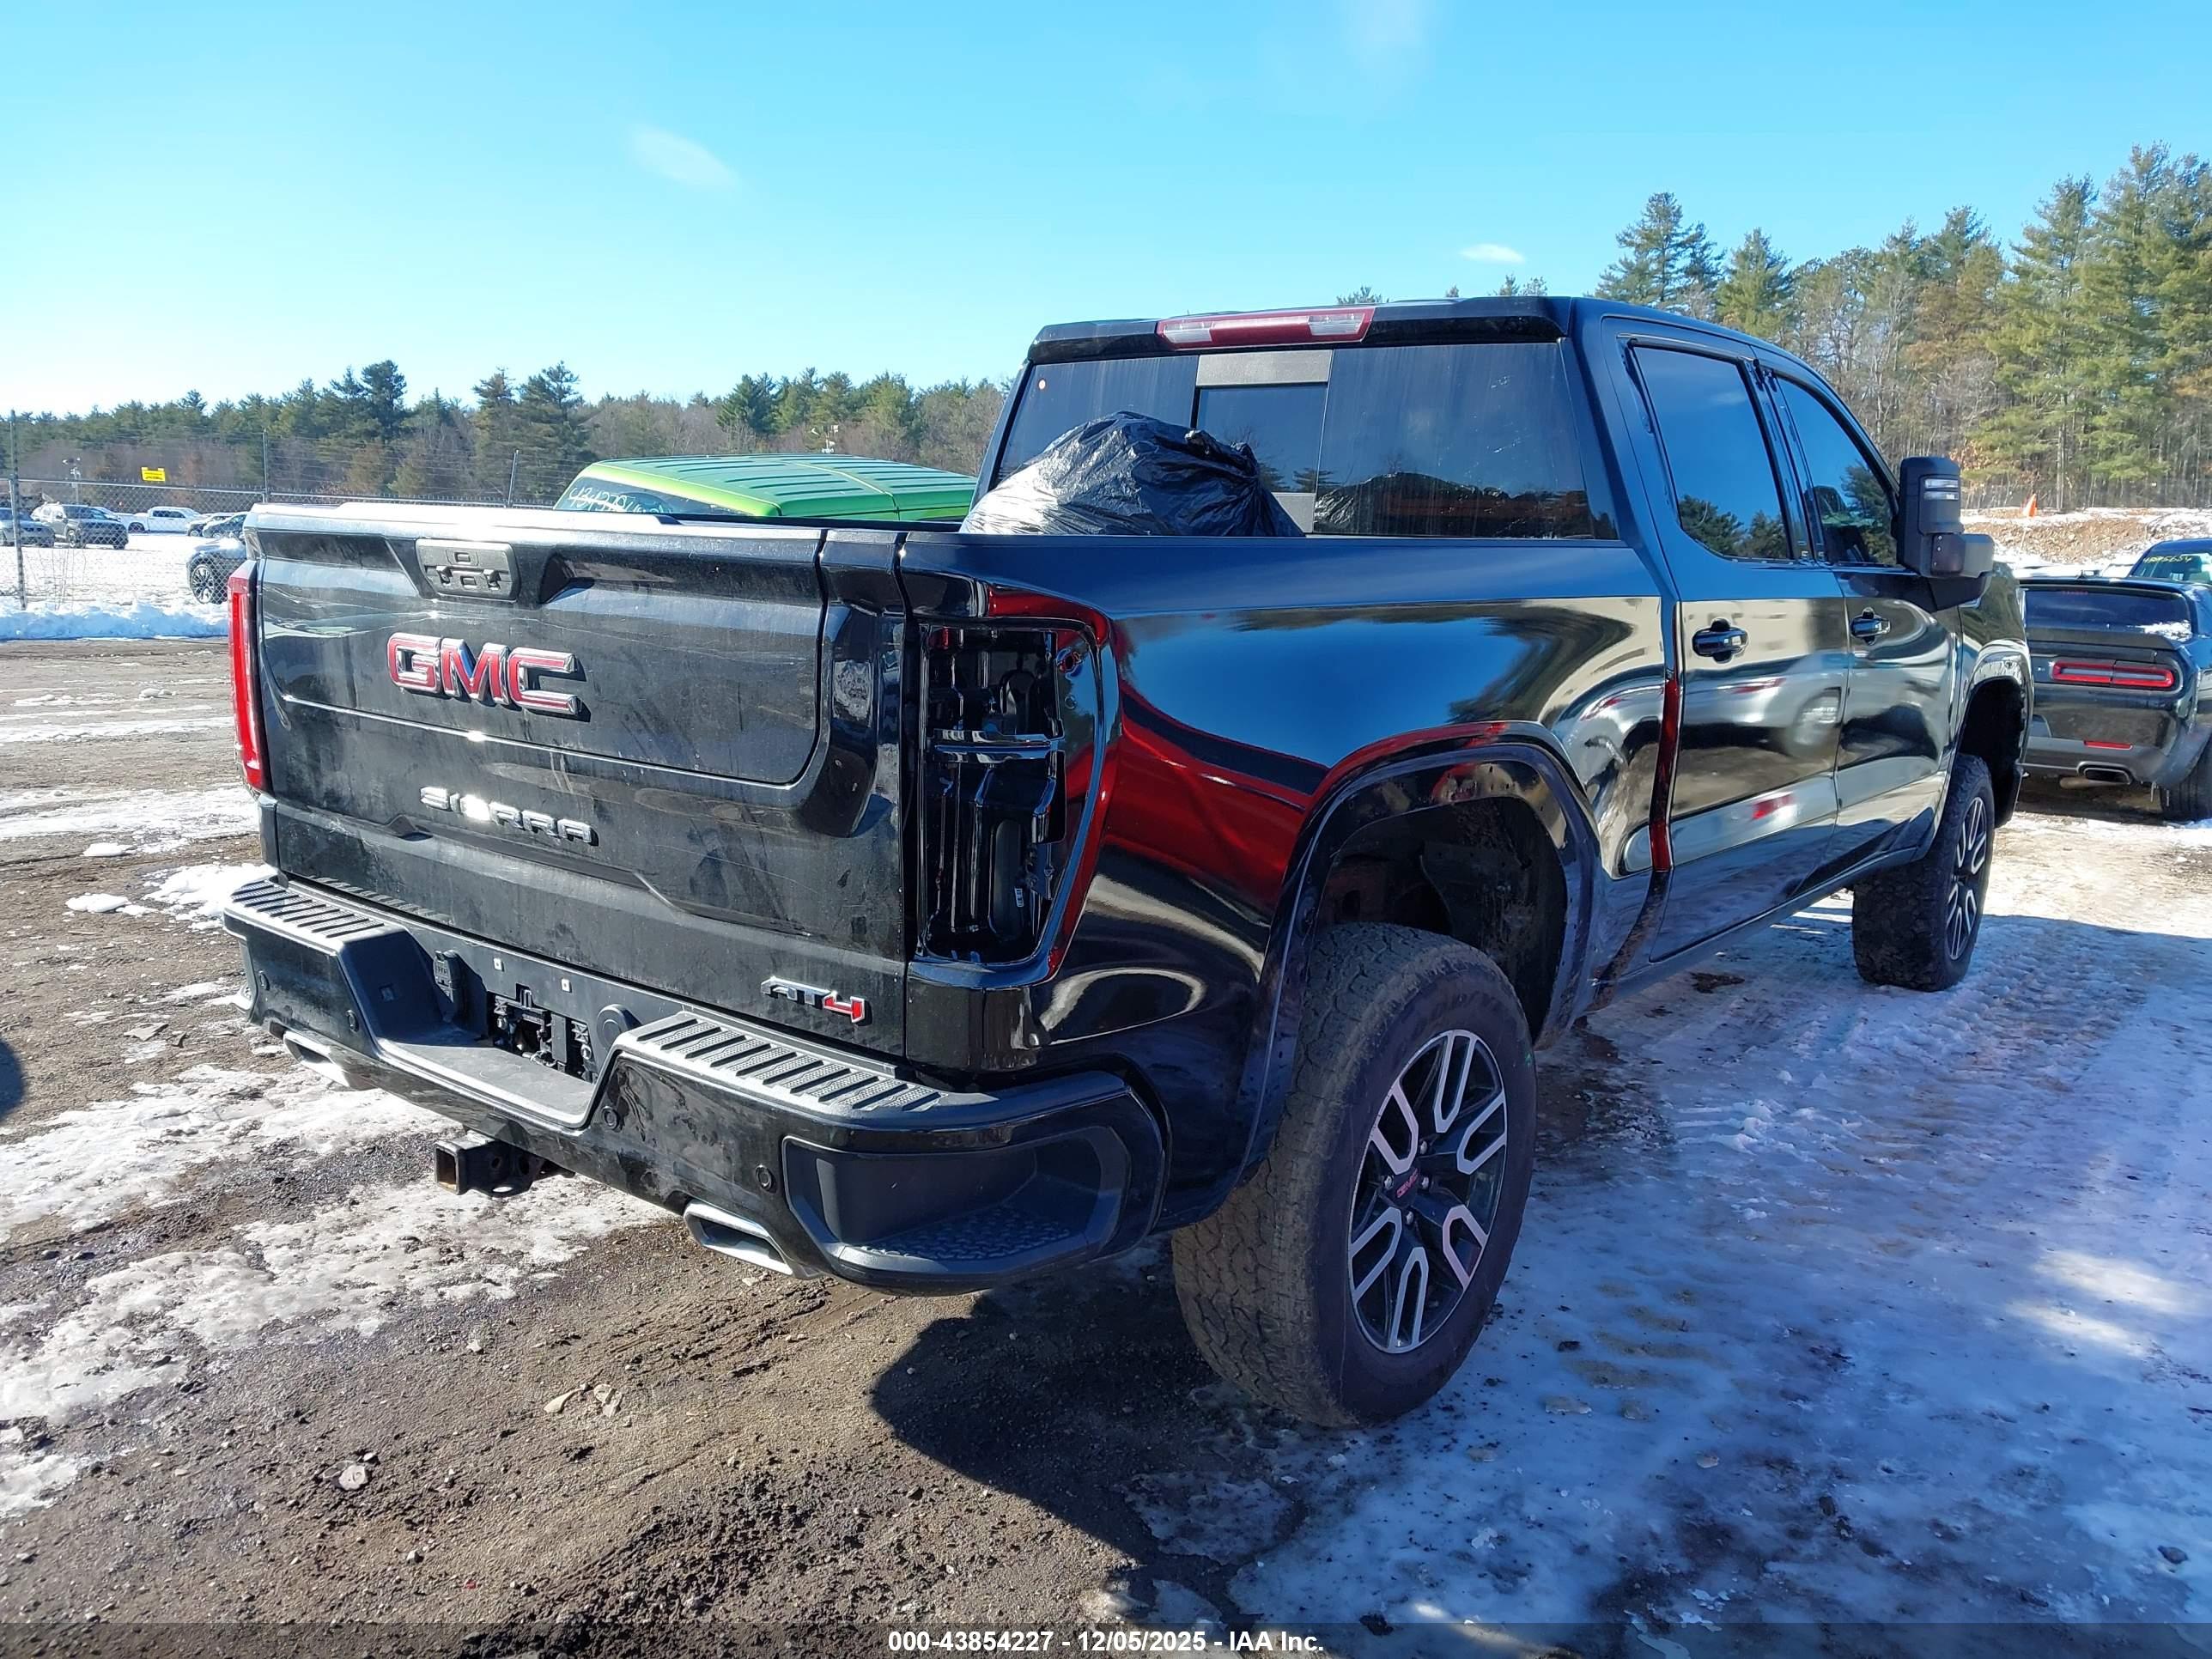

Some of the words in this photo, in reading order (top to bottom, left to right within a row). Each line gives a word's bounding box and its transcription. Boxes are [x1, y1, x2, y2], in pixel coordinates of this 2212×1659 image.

[386, 632, 578, 715] GMC
[420, 787, 592, 843] SIRRA
[761, 975, 866, 1024] AT4
